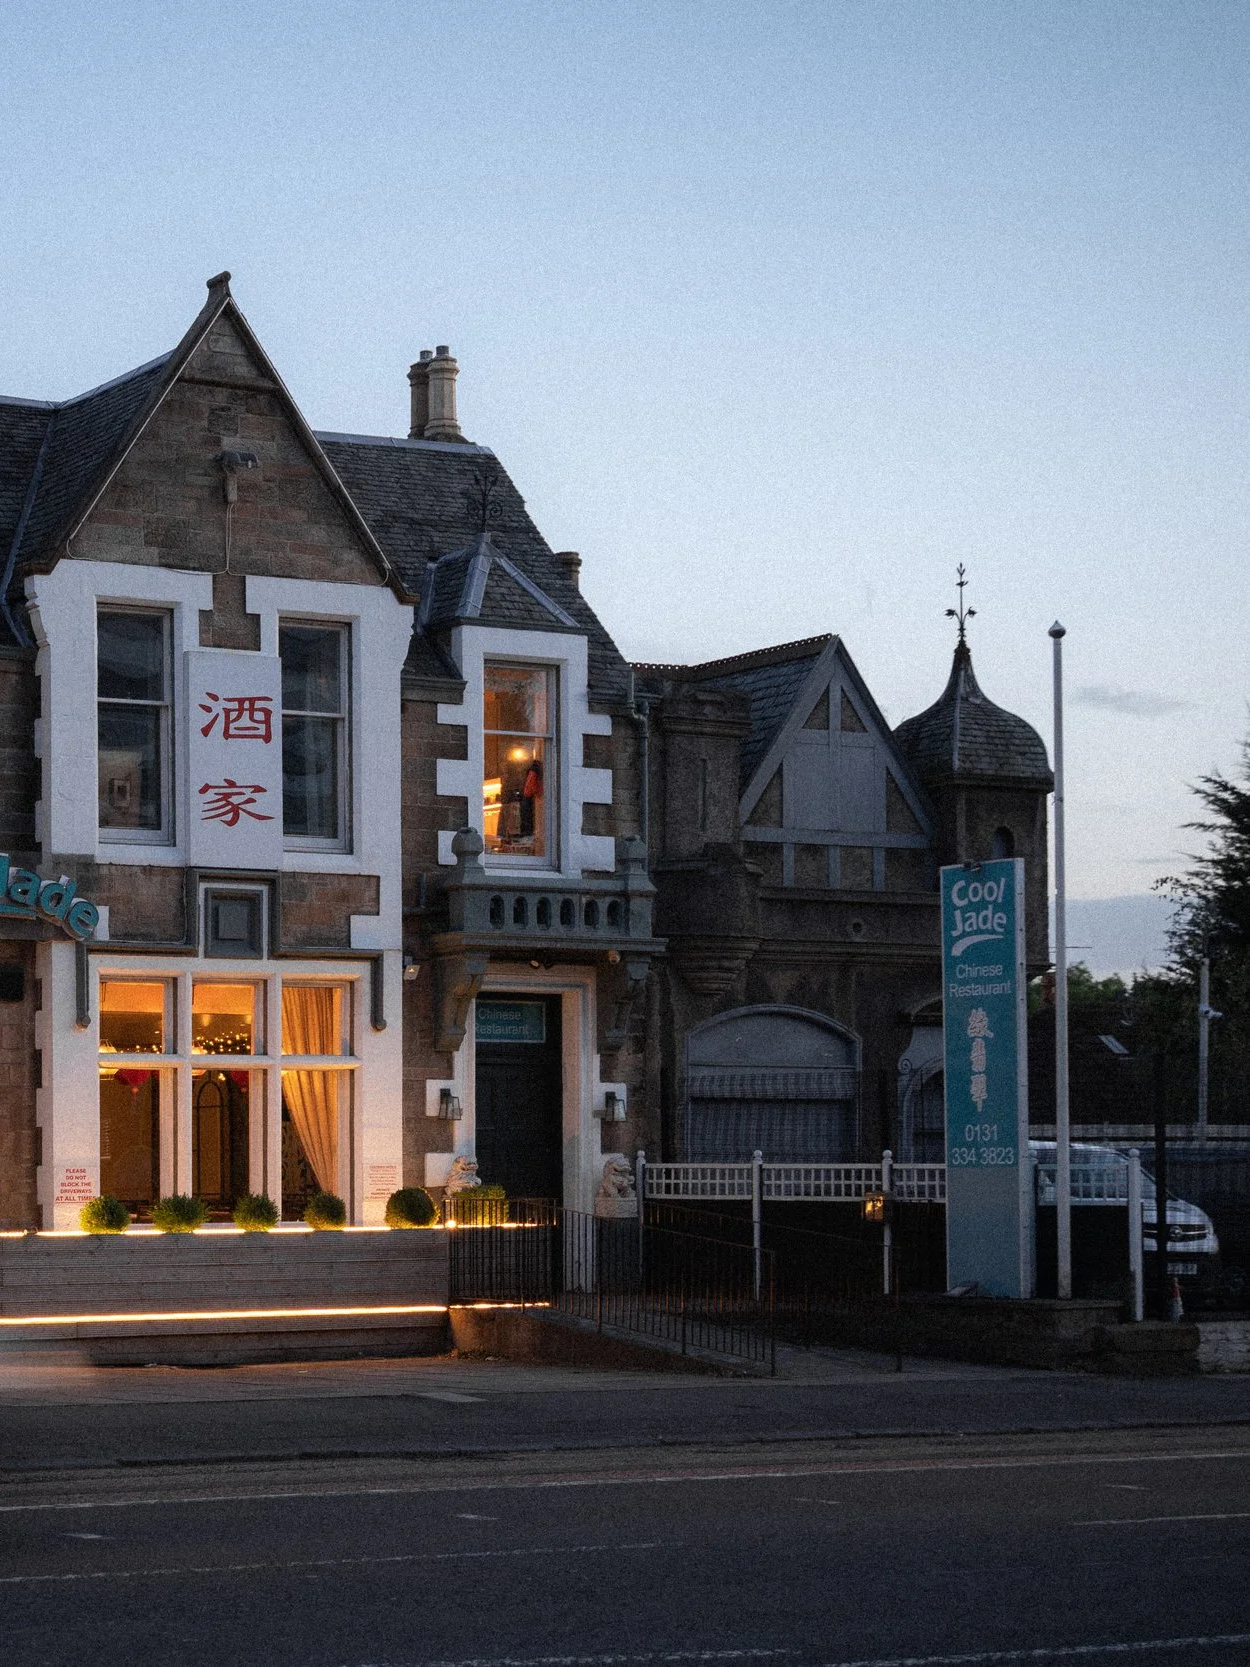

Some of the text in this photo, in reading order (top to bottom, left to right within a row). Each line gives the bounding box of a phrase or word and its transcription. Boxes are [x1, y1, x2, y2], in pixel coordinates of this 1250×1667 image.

[198, 691, 275, 827] 酒家
[952, 877, 1006, 908] Cool
[951, 904, 1007, 938] Jade
[956, 962, 1003, 979] Chinese
[949, 981, 1012, 998] Restaurant
[479, 1008, 521, 1020] Chinese
[965, 1123, 998, 1141] 0131
[952, 1146, 1014, 1165] 334 3823
